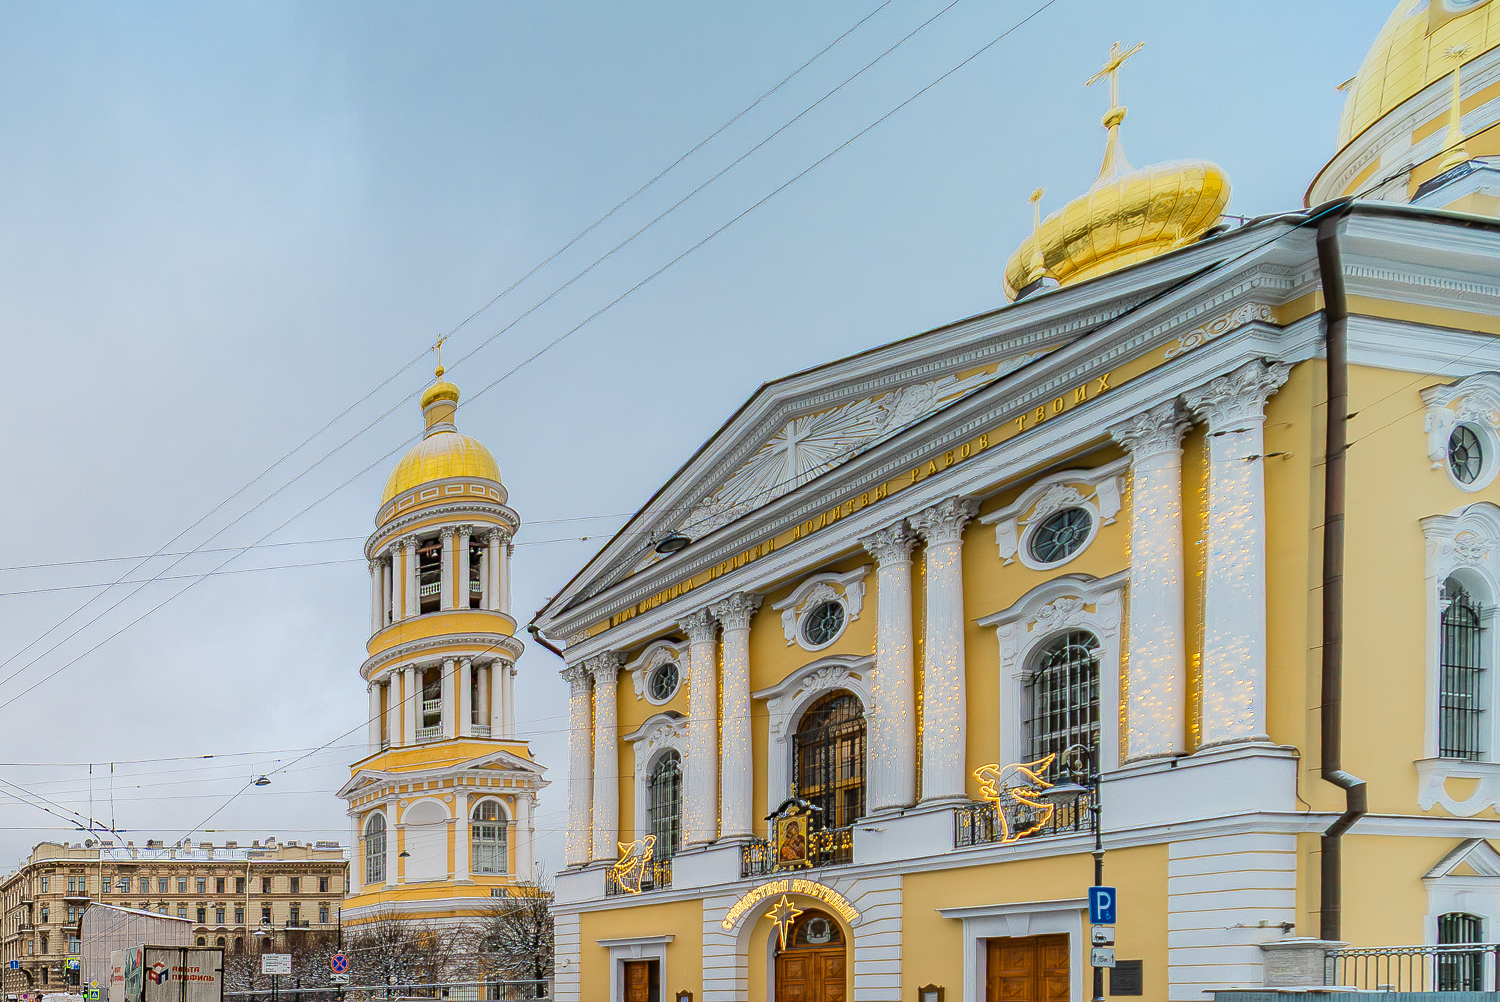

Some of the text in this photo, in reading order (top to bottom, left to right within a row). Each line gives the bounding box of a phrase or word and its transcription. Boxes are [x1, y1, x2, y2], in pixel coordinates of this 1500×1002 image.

[793, 483, 889, 539] МОЛИТВЫ
[911, 433, 989, 483] РАБОВ
[1015, 372, 1112, 433] ТВОИХ
[1097, 891, 1112, 920] P
